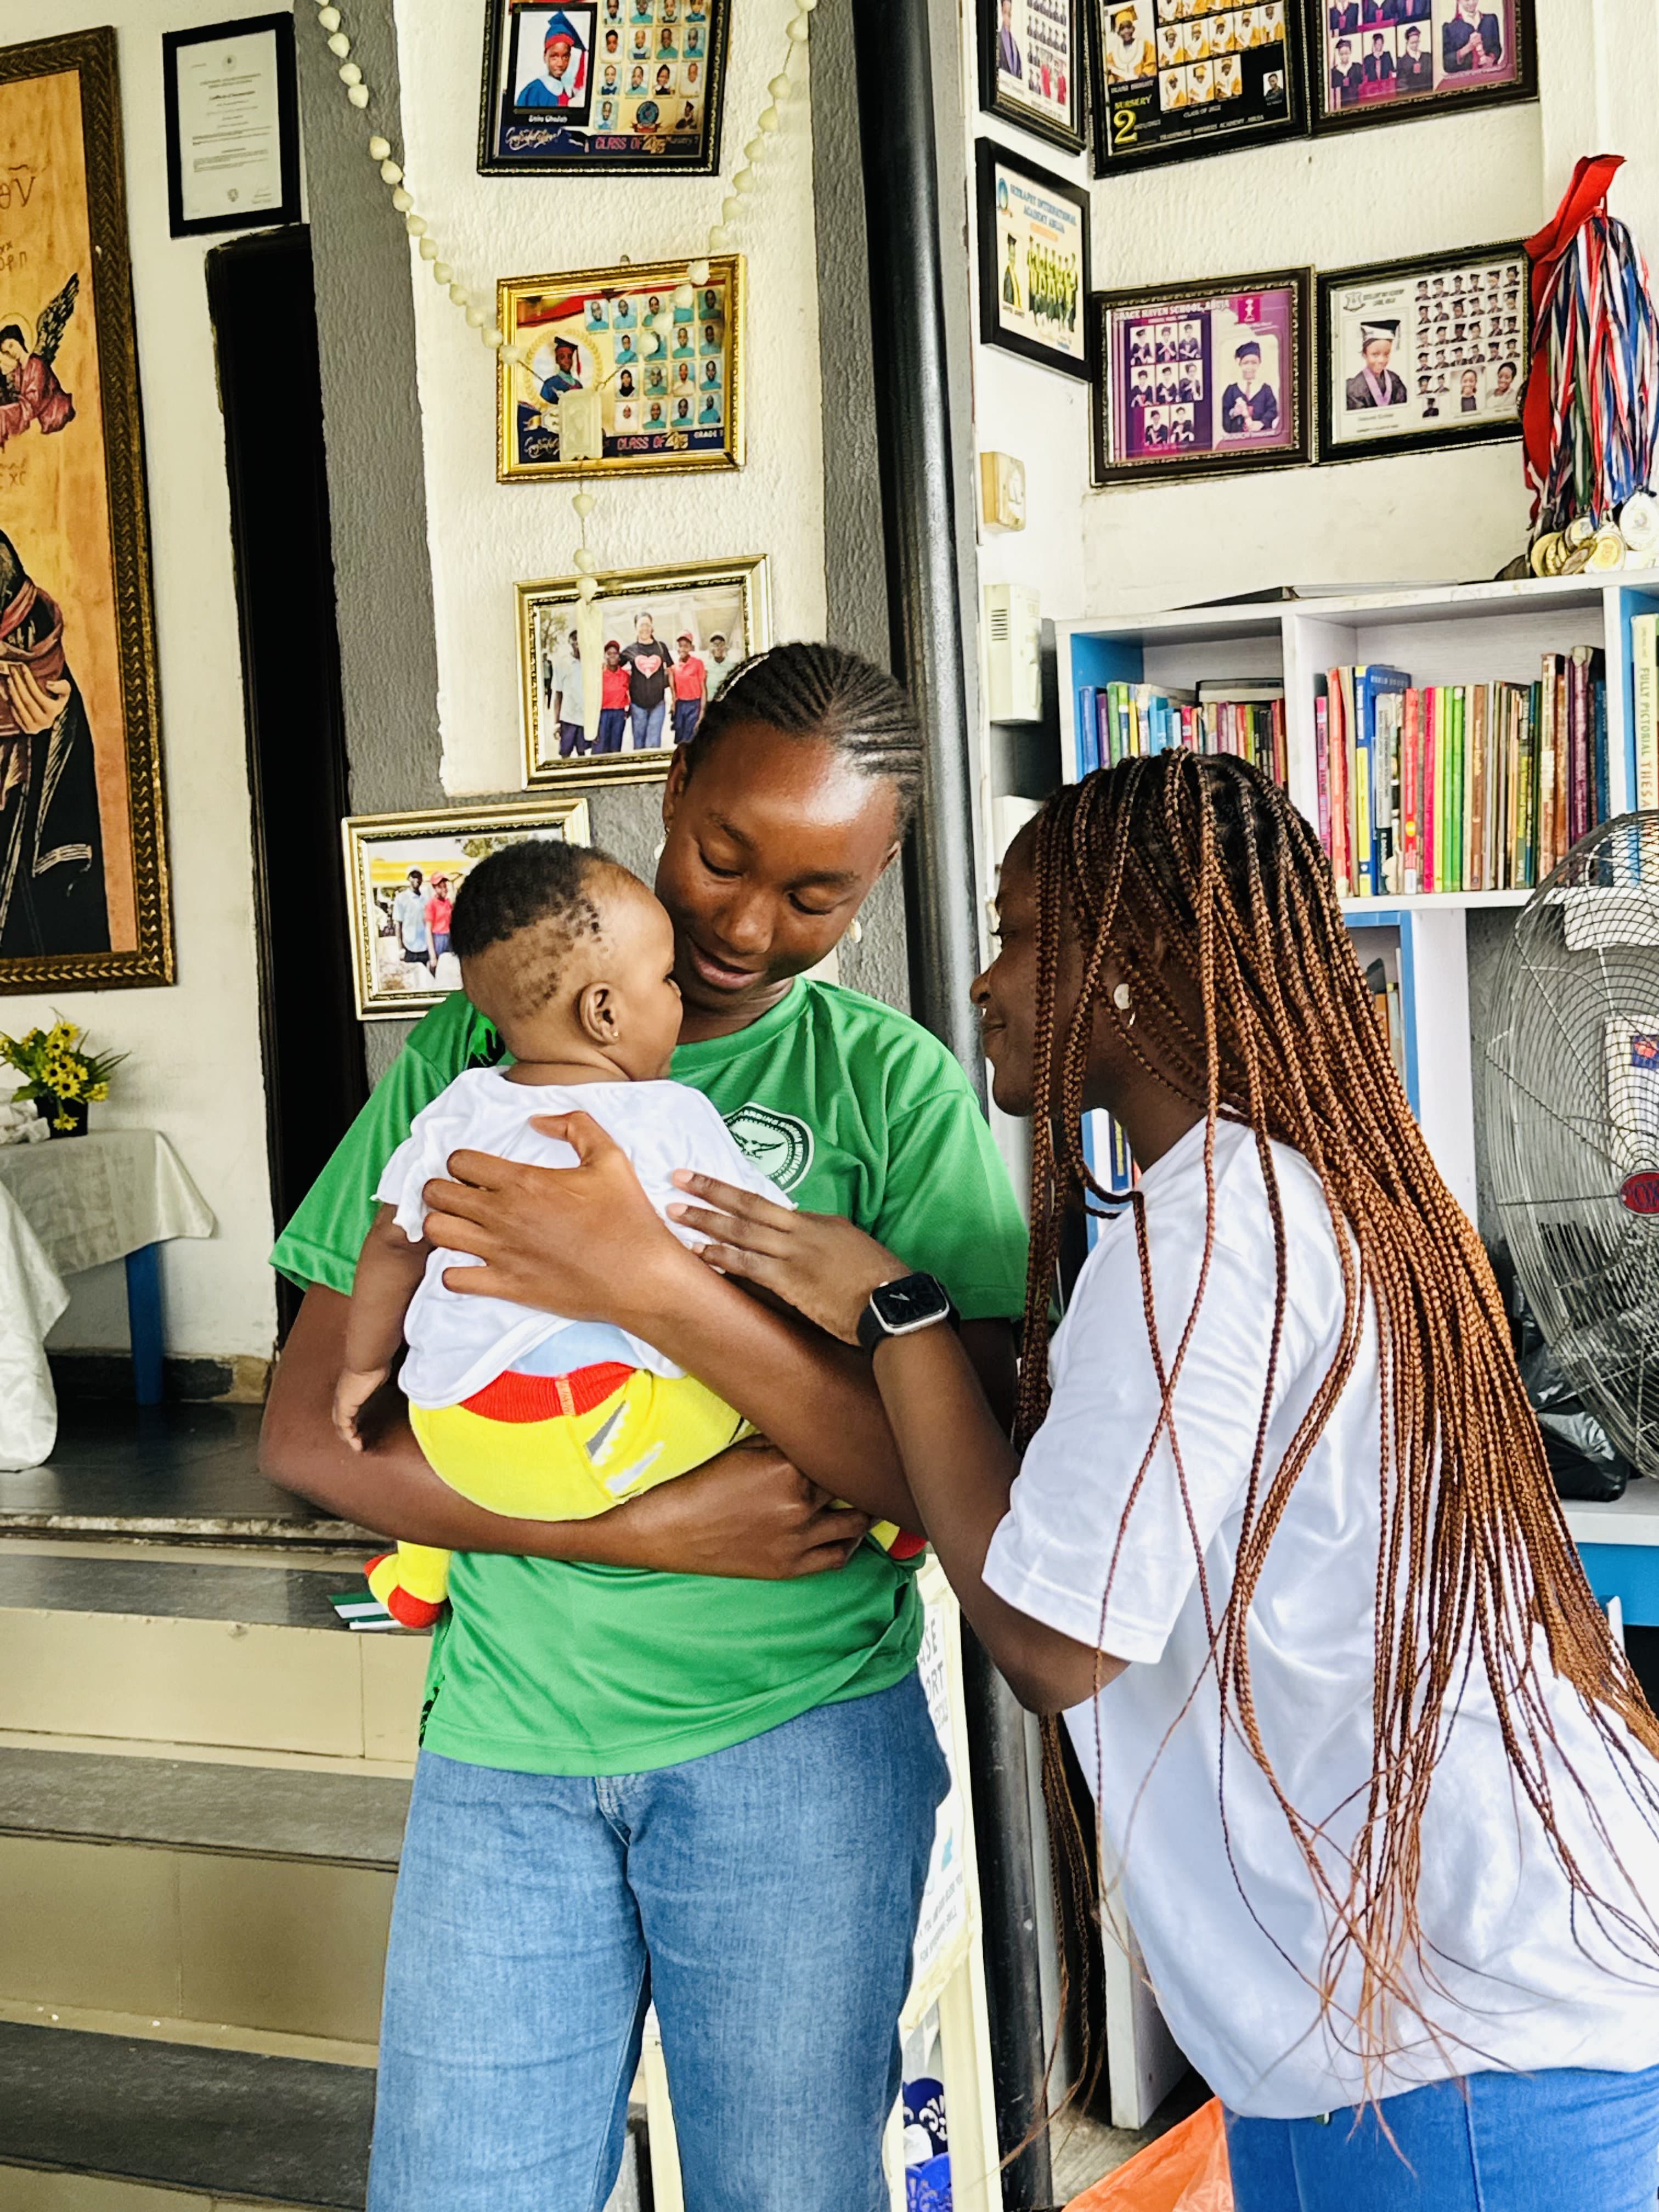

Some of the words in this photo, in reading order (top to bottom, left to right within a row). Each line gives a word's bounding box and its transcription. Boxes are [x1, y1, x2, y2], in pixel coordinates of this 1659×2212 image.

[595, 137, 627, 150] CLASS
[1114, 110, 1138, 144] 2
[617, 437, 649, 451] CLASS
[1639, 667, 1650, 698] FULLY
[1640, 702, 1651, 757] PICTORIAL
[1640, 760, 1653, 808] THESA
[919, 1617, 938, 1666] ASE
[925, 1659, 944, 1704] ORT
